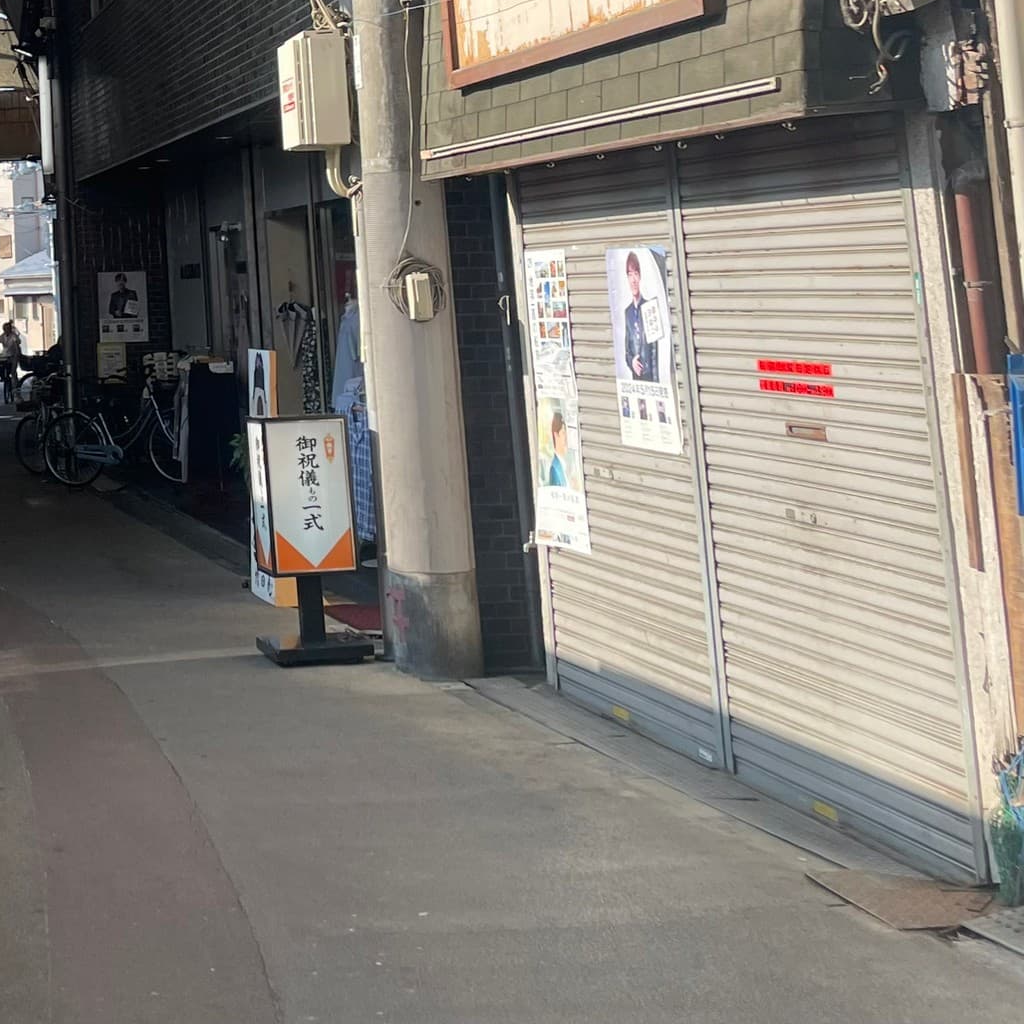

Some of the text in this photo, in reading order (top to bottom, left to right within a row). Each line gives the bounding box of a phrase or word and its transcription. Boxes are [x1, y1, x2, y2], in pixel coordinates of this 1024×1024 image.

[296, 435, 324, 531] 御祝儀もの一式
